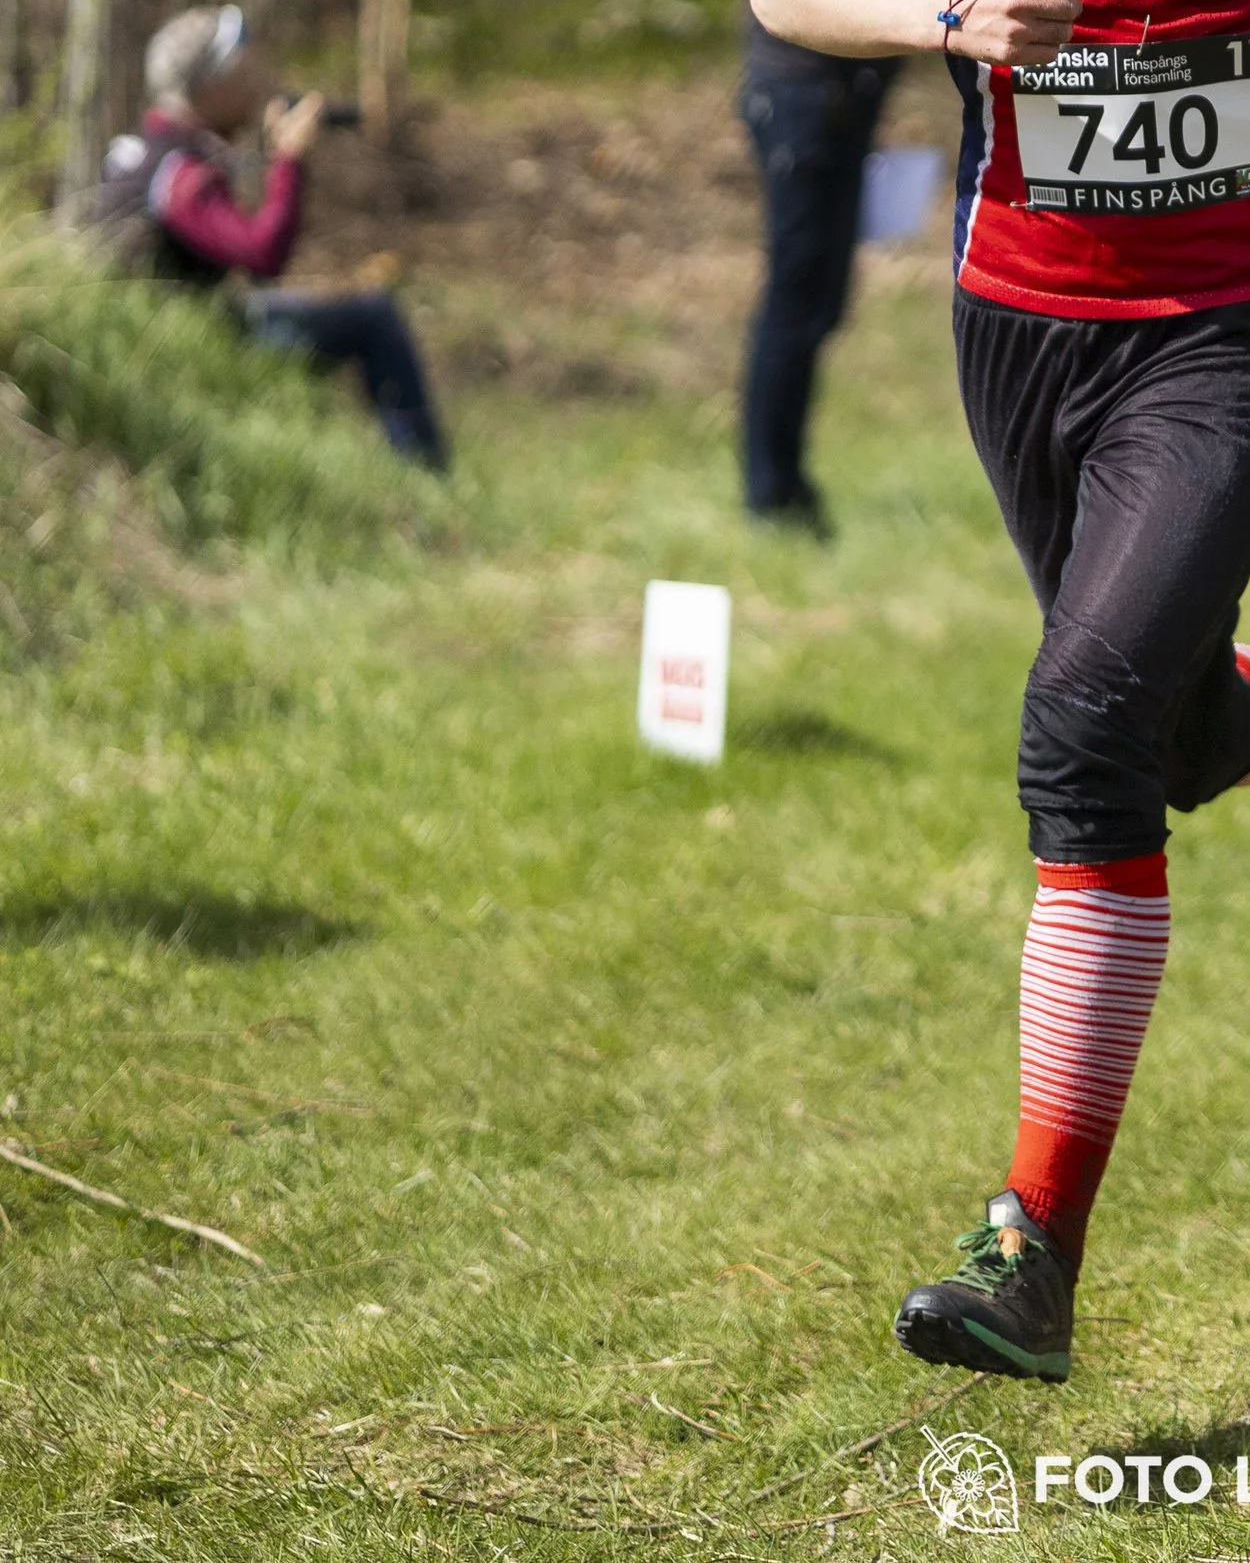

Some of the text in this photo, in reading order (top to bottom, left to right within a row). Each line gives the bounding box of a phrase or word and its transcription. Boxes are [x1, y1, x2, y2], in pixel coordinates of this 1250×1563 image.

[1012, 48, 1109, 68] nska
[1123, 54, 1188, 71] Finspångs
[1226, 41, 1244, 76] 1
[1020, 68, 1094, 90] kyrkan
[1124, 67, 1192, 86] församling
[1057, 94, 1219, 175] 740
[1074, 177, 1227, 208] FINSPÅNG
